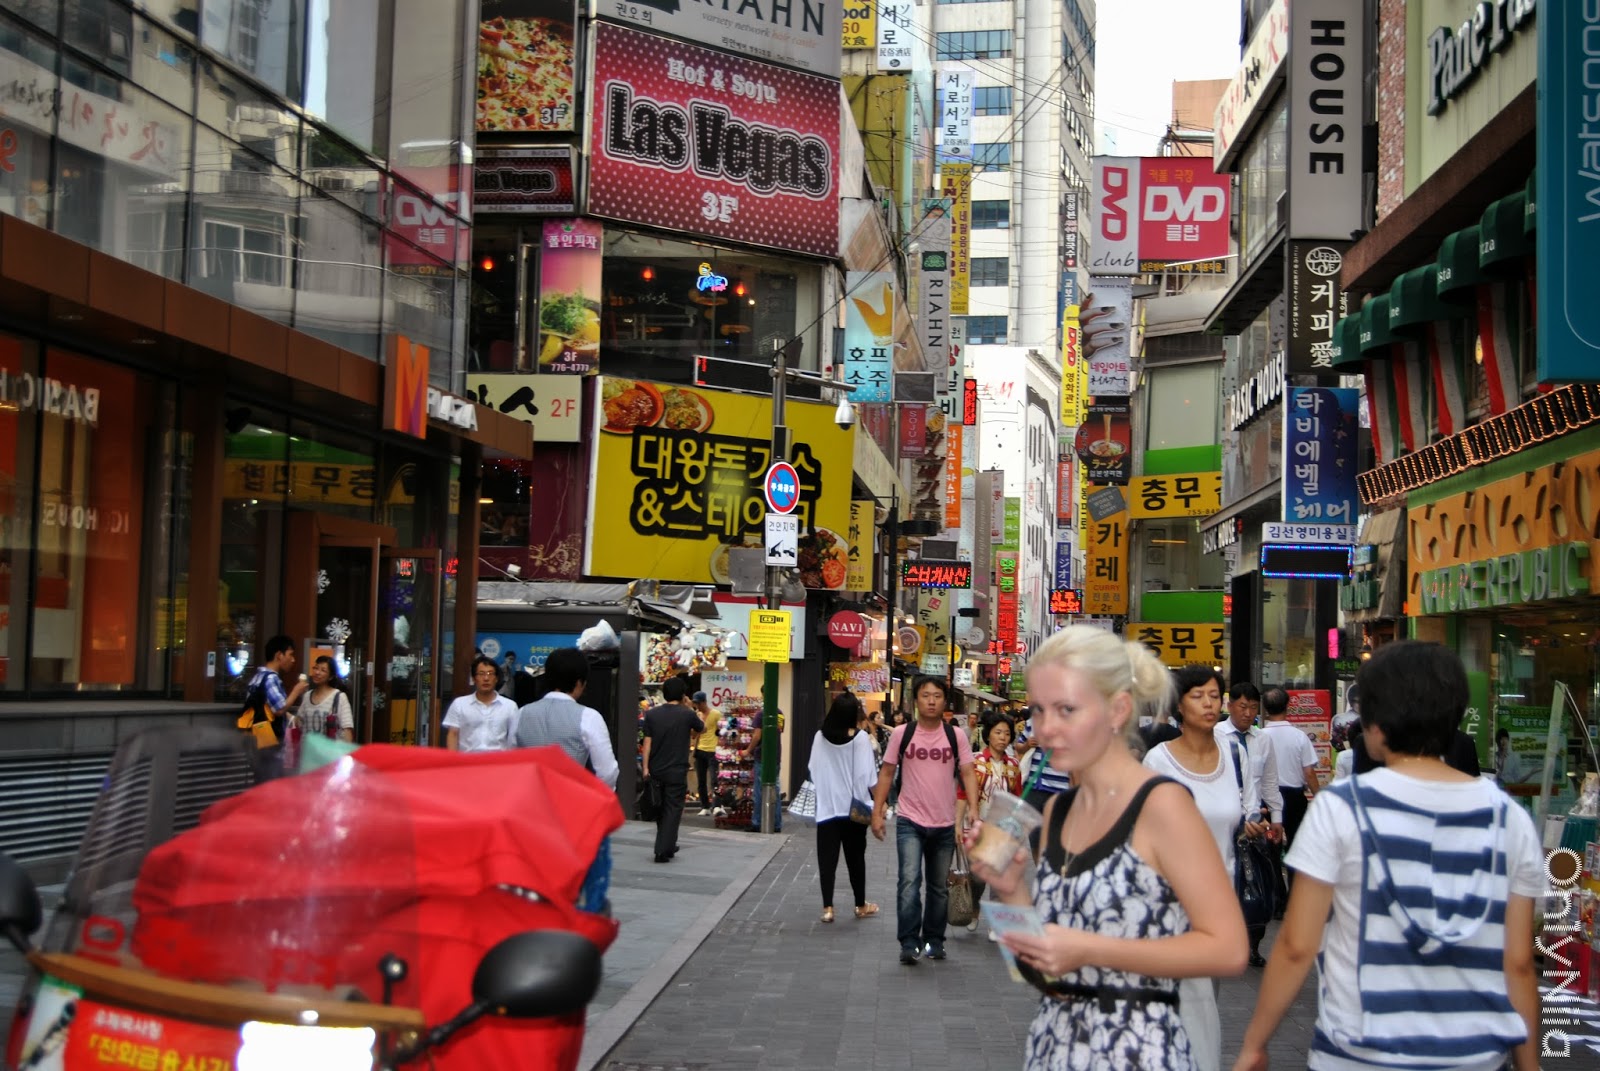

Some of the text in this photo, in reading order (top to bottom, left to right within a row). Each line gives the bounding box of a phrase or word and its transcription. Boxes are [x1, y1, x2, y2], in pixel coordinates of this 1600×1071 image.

[735, 18, 770, 38] network
[1427, 4, 1486, 115] Pane
[667, 57, 777, 103] Hof & Soju
[945, 74, 959, 136] 서로서로
[1308, 20, 1346, 175] HOUSE
[539, 104, 567, 125] 3F
[606, 81, 831, 199] Las Vegas
[1149, 169, 1193, 182] 커플 극장
[701, 191, 739, 222] 3F
[1101, 166, 1128, 241] DVD
[1143, 186, 1225, 221] DVD
[1166, 224, 1199, 241] 클럽
[1093, 251, 1135, 267] club
[1311, 261, 1335, 275] LOVE
[929, 279, 943, 347] RIAHN
[1310, 280, 1333, 367] 커피愛
[847, 348, 888, 363] 호프
[1067, 326, 1077, 367] DVD
[564, 352, 578, 362] 3F
[1090, 361, 1127, 373] 네일아트
[551, 364, 589, 372] 776-4777
[385, 334, 479, 439] M PLAZA
[847, 371, 888, 386] 소주
[876, 390, 887, 399] 3F
[1231, 377, 1254, 431] BASIC
[551, 399, 575, 417] 2F
[908, 410, 917, 438] SOJU
[1295, 393, 1323, 497] 라비에벨
[1091, 459, 1123, 470] ラーメン
[770, 483, 795, 493] 주차금지
[1293, 497, 1350, 523] 헤어
[769, 521, 796, 532] 견인지역
[1268, 526, 1347, 540] 김선영미용실
[1095, 523, 1122, 581] 카레
[1487, 542, 1588, 606] REPUBLIC
[1092, 593, 1121, 601] 전문점
[1101, 604, 1112, 612] 2F
[831, 620, 863, 633] NAVI
[905, 743, 953, 763] Jeep
